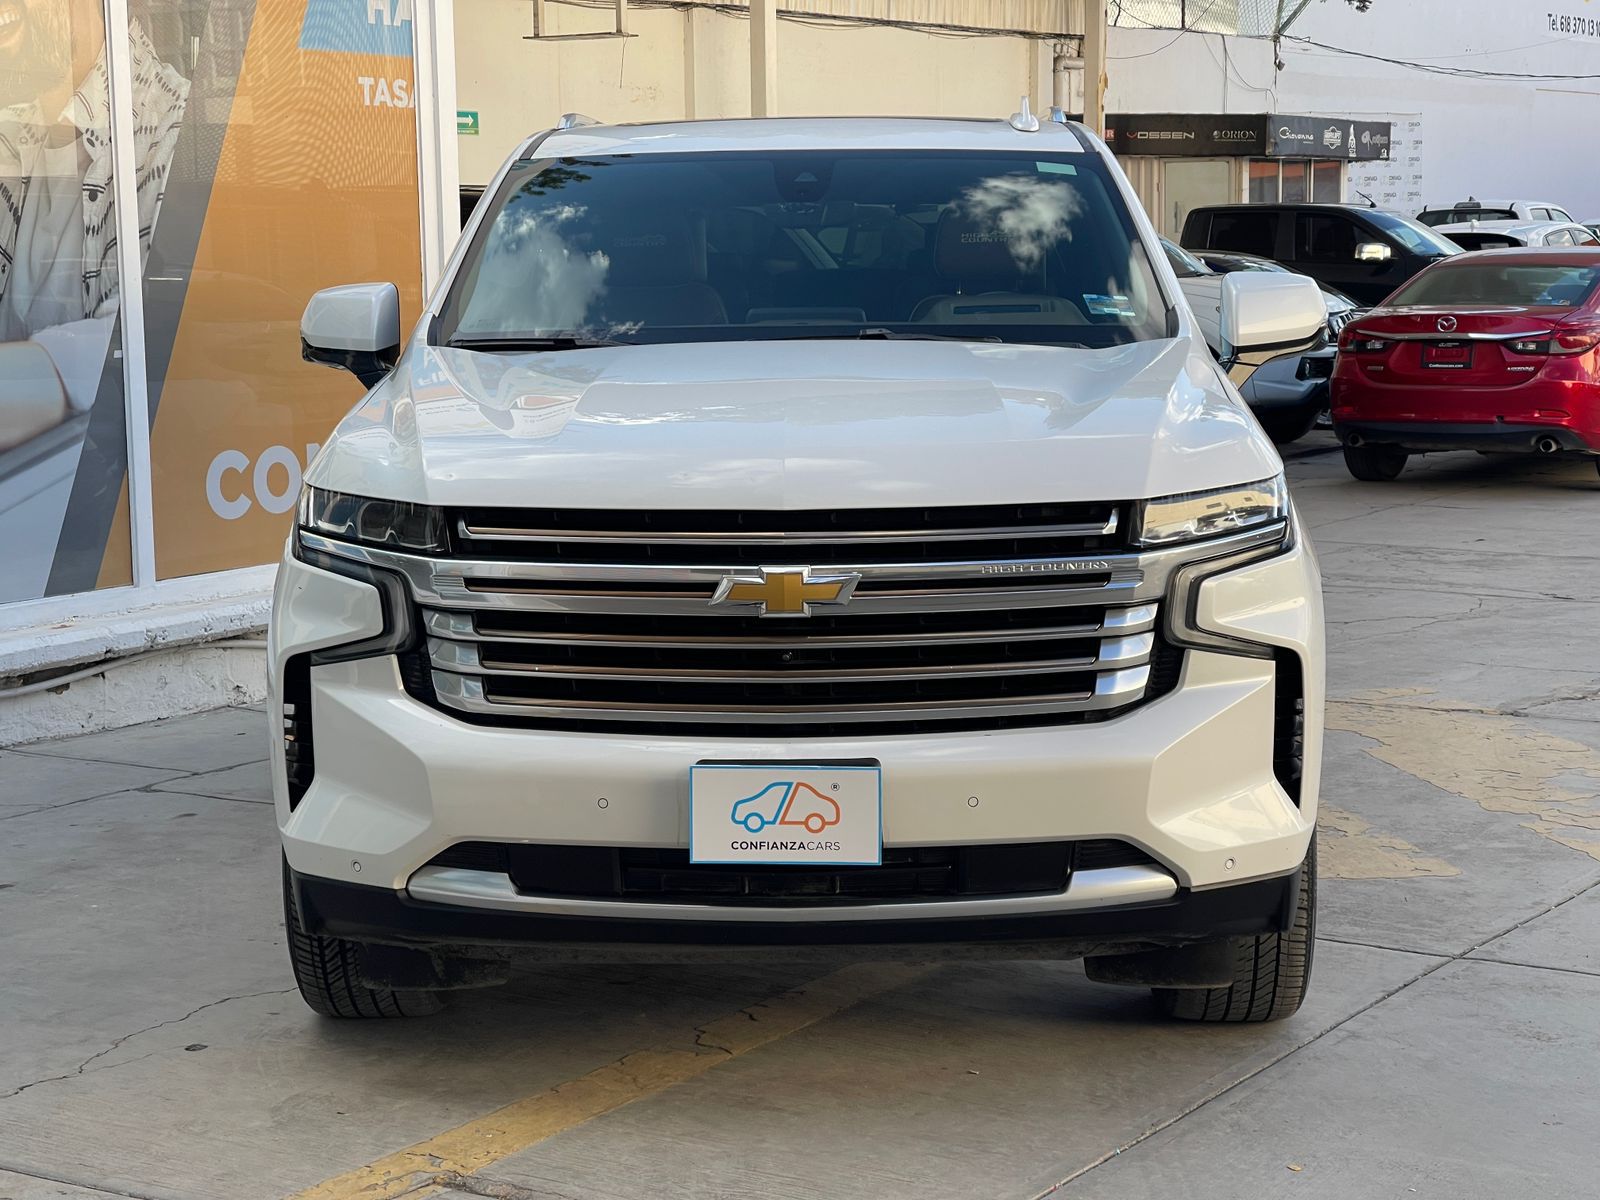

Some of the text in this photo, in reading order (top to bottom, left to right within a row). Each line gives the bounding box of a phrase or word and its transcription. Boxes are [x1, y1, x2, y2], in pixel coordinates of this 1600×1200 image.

[1560, 15, 1571, 33] 618
[1573, 16, 1586, 35] 370
[1126, 131, 1195, 140] VOSSEN
[1221, 129, 1257, 139] ORION
[205, 442, 320, 520] CO
[981, 560, 1112, 574] HIGH COUNTRY
[731, 841, 841, 851] CONFIANZACARS
